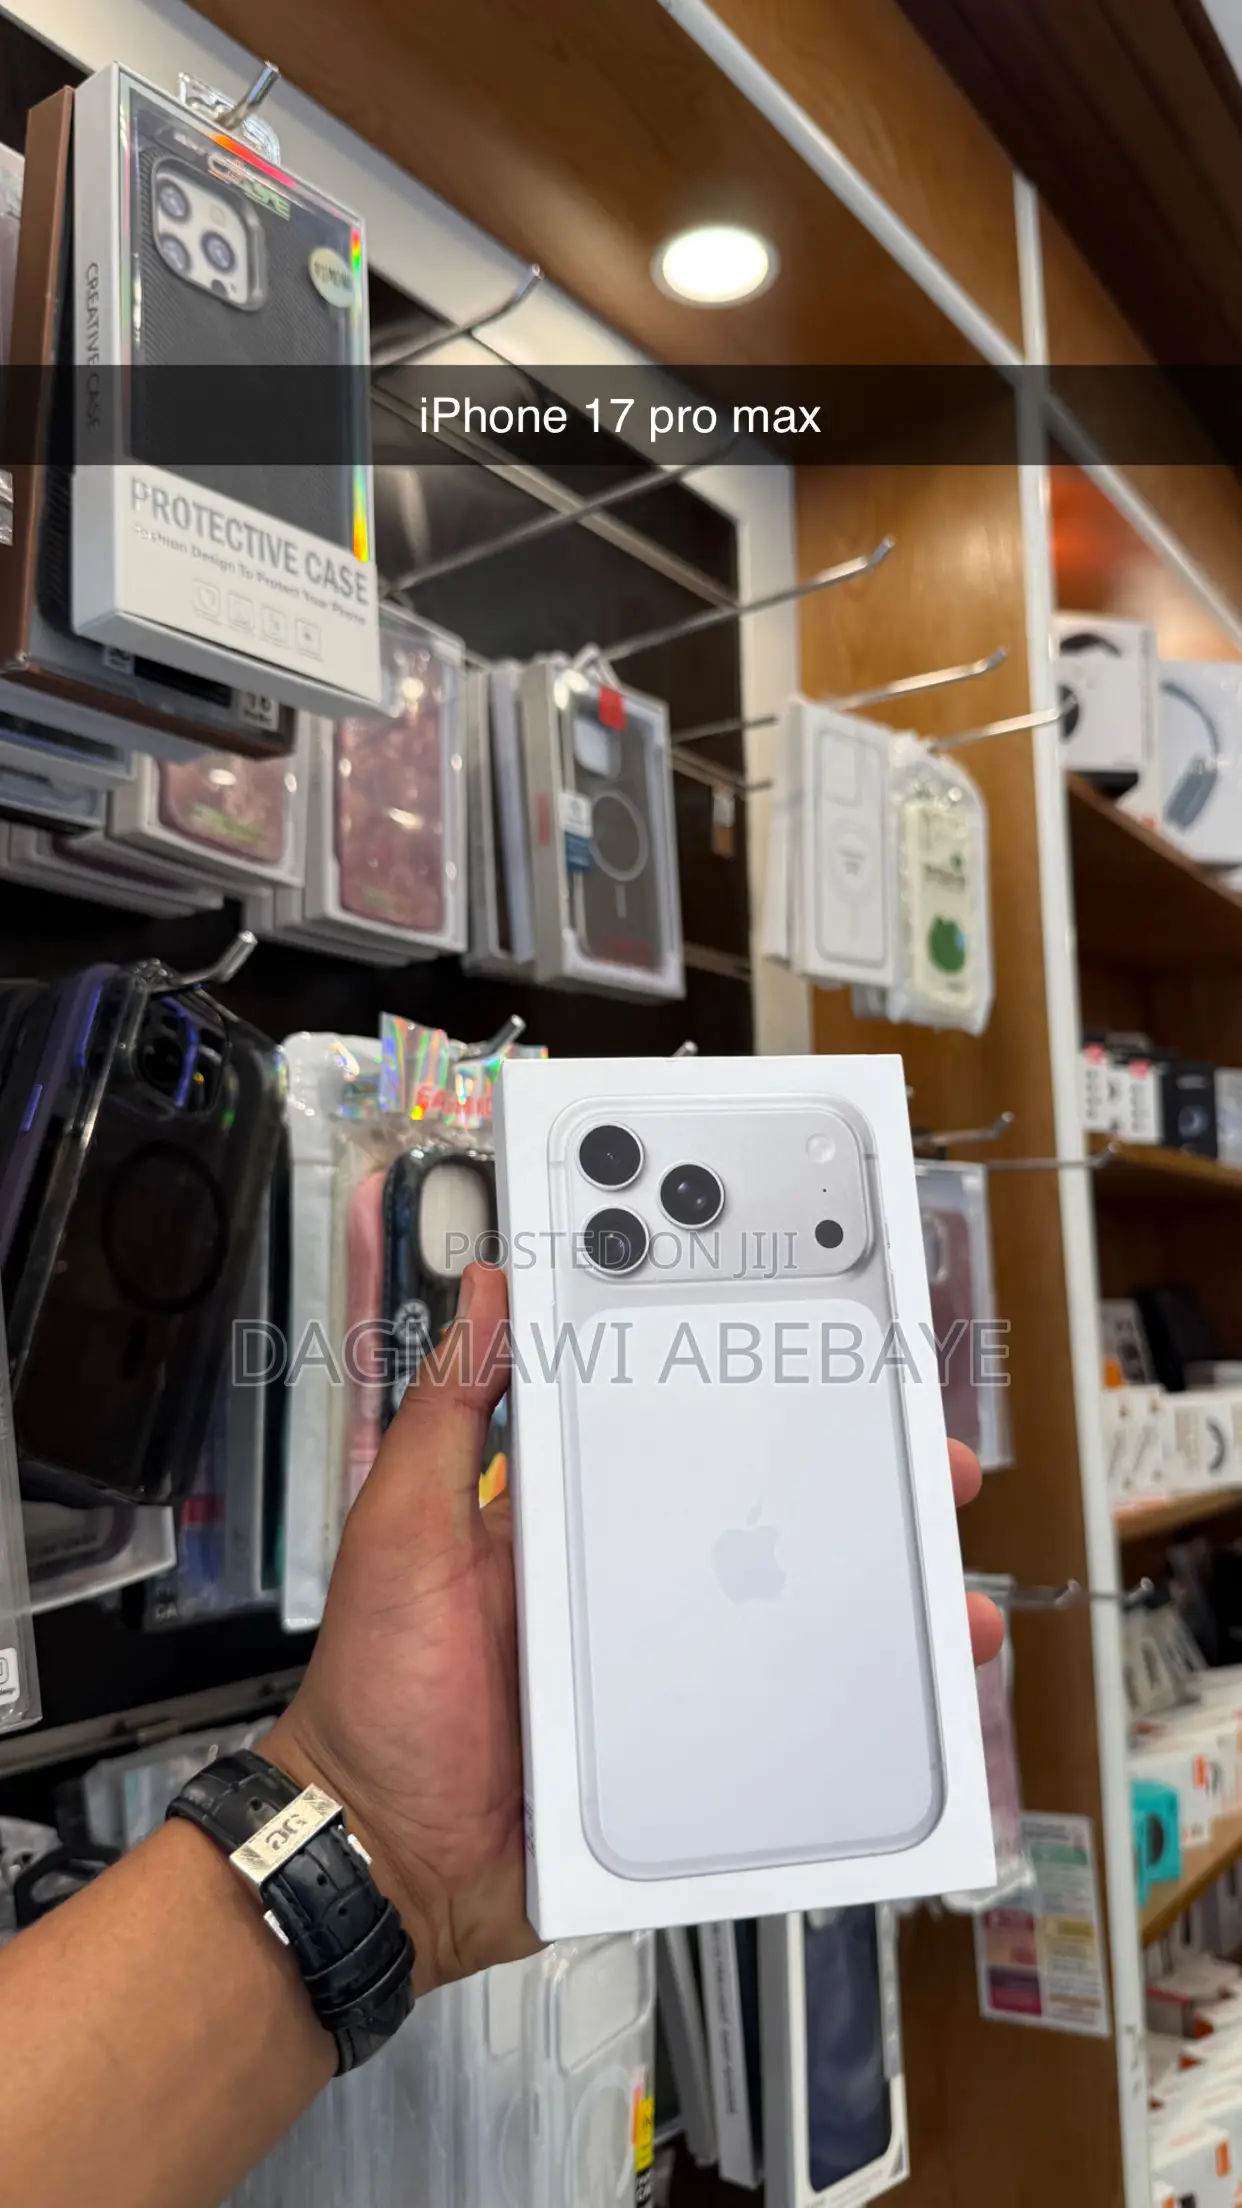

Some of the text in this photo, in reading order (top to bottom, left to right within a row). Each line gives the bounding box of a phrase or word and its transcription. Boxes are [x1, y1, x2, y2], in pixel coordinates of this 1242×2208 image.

[85, 262, 100, 368] CREATIVE
[131, 475, 369, 606] PROTECTIVE CASE
